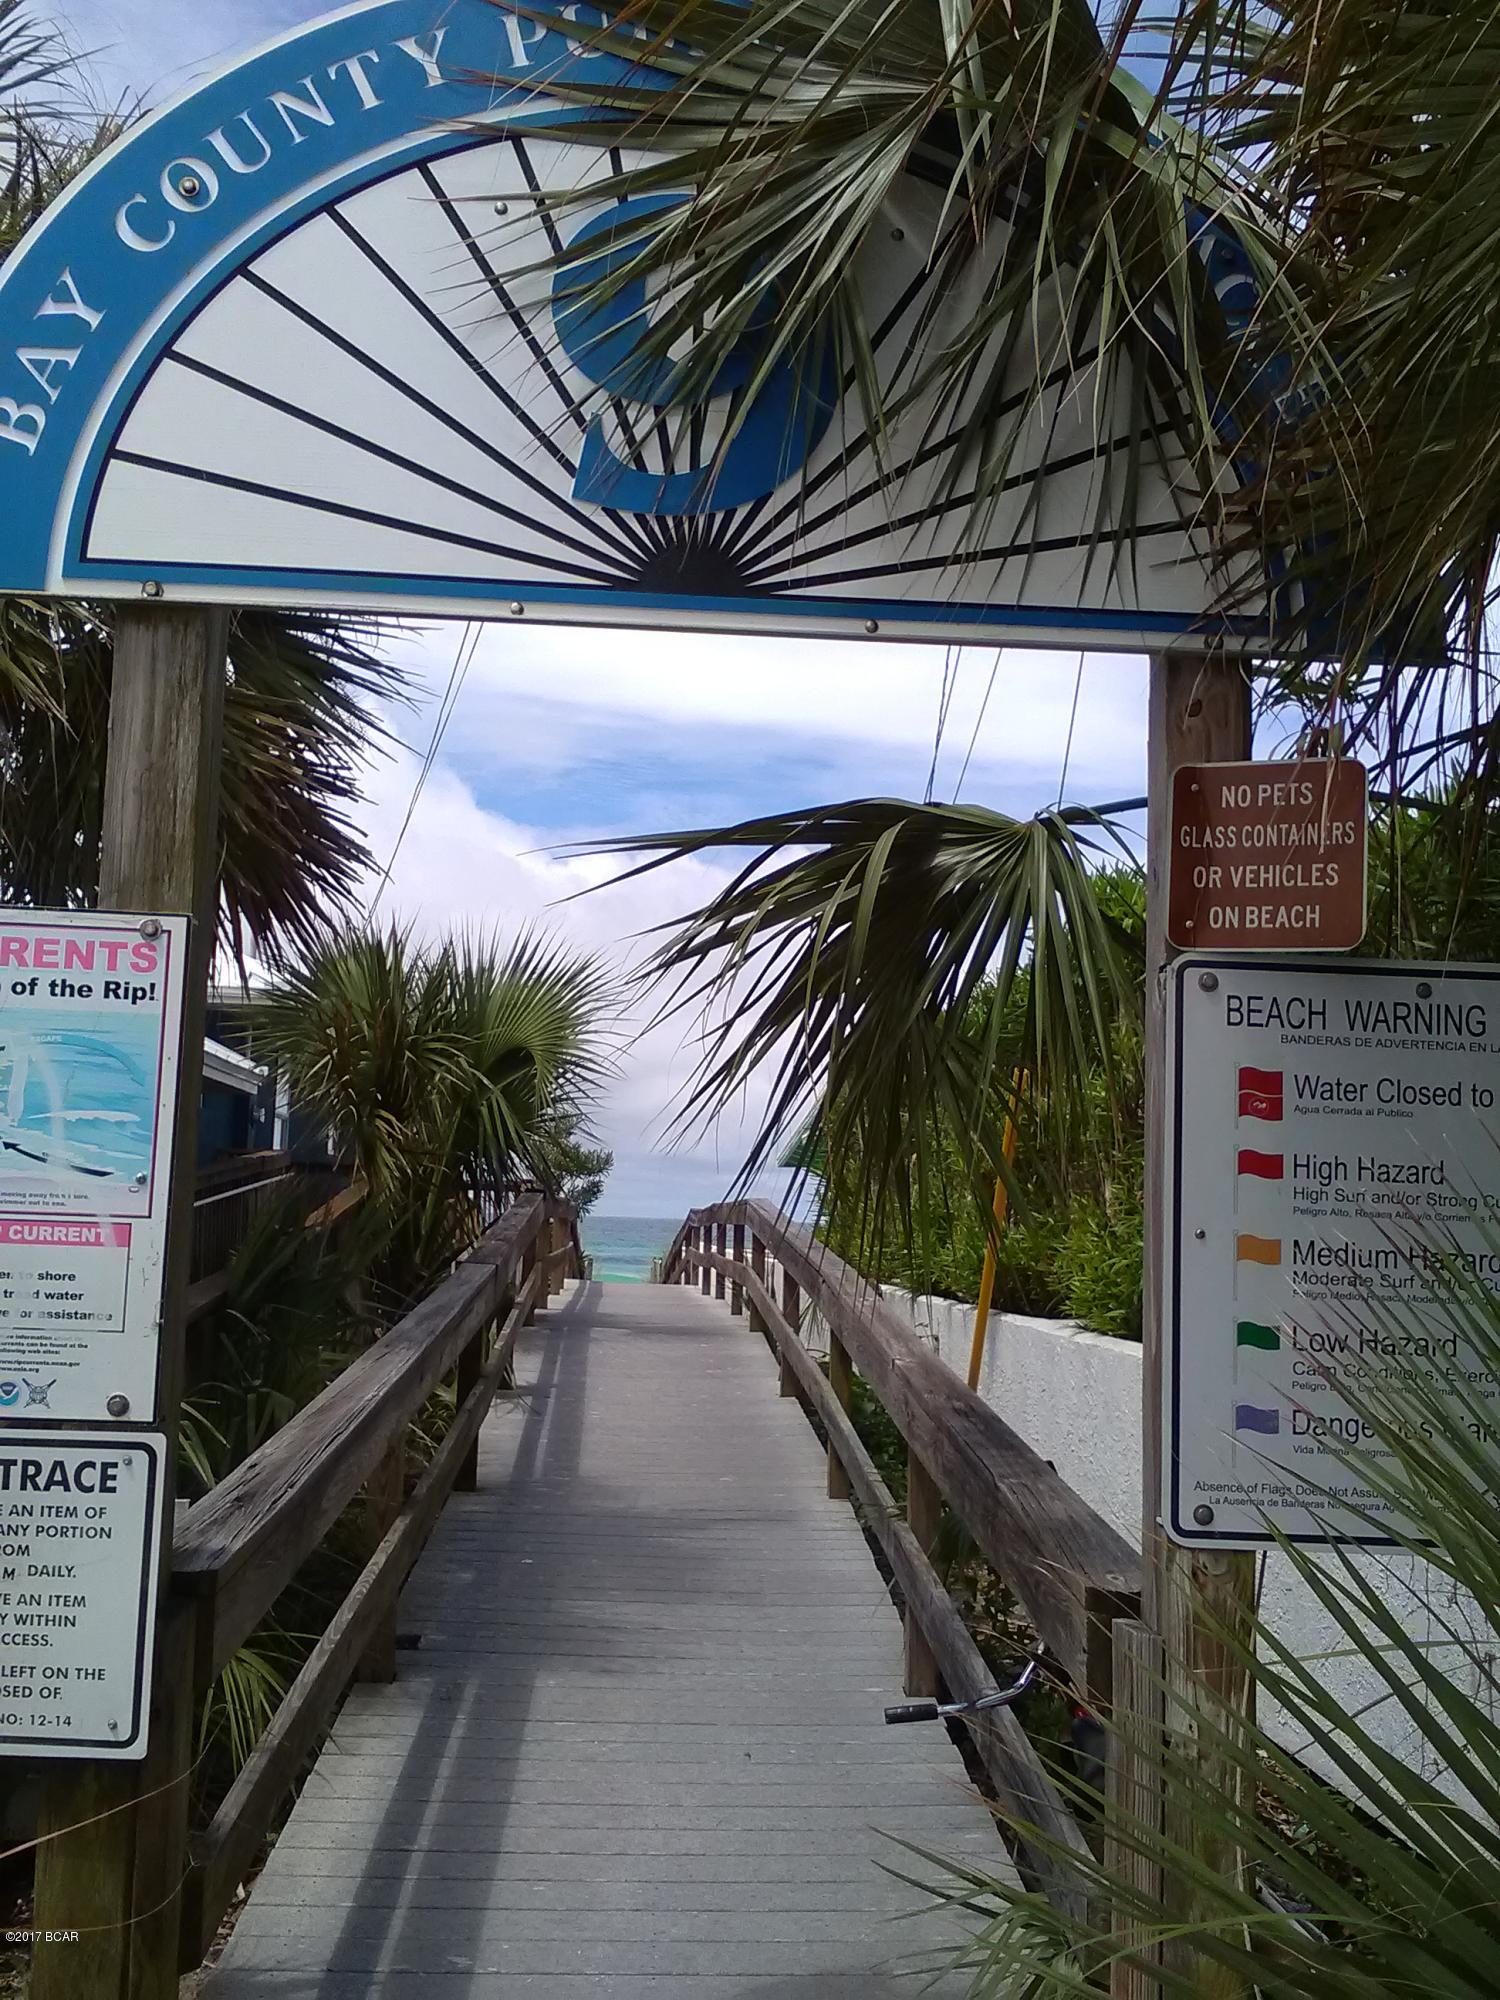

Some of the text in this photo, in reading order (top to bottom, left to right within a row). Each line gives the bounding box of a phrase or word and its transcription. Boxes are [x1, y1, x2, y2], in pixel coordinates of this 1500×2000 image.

[0, 26, 450, 456] BAY COUNTY
[1221, 782, 1313, 808] NO PETS
[1181, 826, 1236, 848] GLASS
[1193, 863, 1339, 888] OR VEHICLES
[1209, 905, 1320, 928] ON BEACH
[0, 936, 158, 973] RENTS
[11, 977, 156, 1005] of the Rip!
[1226, 995, 1487, 1037] BEACH WARNING
[1281, 1034, 1351, 1047] BANDERAS
[1355, 1037, 1373, 1048] DE
[1375, 1038, 1465, 1051] ADVERTENCIA
[1470, 1041, 1487, 1052] EN
[1294, 1074, 1494, 1108] Water Closed to
[1293, 1105, 1320, 1115] Agua
[1322, 1106, 1362, 1116] Cerrada
[1377, 1108, 1413, 1118] Publico
[1293, 1153, 1444, 1187] High Hazard
[1293, 1186, 1329, 1204] High
[1293, 1206, 1327, 1217] Peligro
[9, 1225, 104, 1243] CURRENT
[1293, 1239, 1397, 1269] Medium
[37, 1271, 76, 1281] shore
[1293, 1270, 1374, 1288] Moderate
[1380, 1273, 1415, 1288] Surf
[3, 1289, 84, 1300] trd water
[1293, 1326, 1348, 1353] Low
[1293, 1361, 1337, 1376] Cam
[1292, 1381, 1327, 1392] Peligro
[1293, 1445, 1314, 1454] Vida
[0, 1458, 119, 1493] TRACE
[1193, 1481, 1245, 1493] Absence
[1247, 1483, 1258, 1493] of
[1329, 1486, 1348, 1498] Not
[1209, 1496, 1220, 1505] La
[1267, 1498, 1278, 1507] de
[1282, 1499, 1325, 1509] Banderas
[8, 1504, 33, 1517] AN
[40, 1505, 78, 1518] ITEM
[84, 1506, 107, 1519] OF
[35, 1525, 112, 1539] PORTION
[27, 1564, 76, 1578] DAILY.
[17, 1594, 42, 1606] AN
[48, 1595, 86, 1608] ITEM
[14, 1613, 77, 1627] WITHIN
[1, 1665, 106, 1681] LEFT ON THE
[39, 1686, 62, 1700] OF.
[30, 1714, 72, 1727] 12-14
